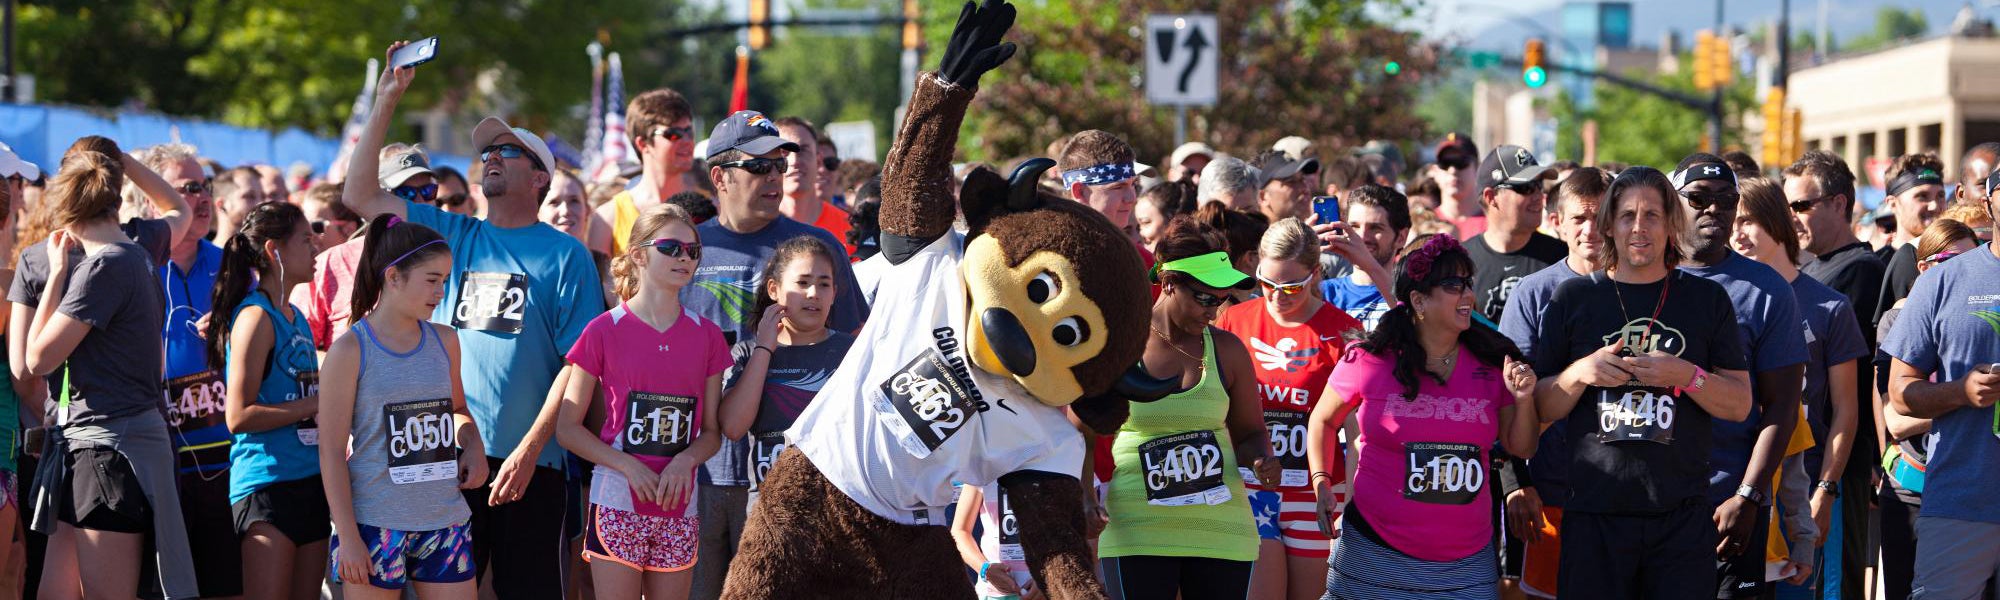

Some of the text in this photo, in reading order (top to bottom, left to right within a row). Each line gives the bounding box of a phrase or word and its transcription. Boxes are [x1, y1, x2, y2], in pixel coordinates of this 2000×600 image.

[907, 377, 965, 441] 462
[405, 412, 454, 452] 050
[1163, 443, 1222, 483] 402
[1427, 456, 1484, 493] 100
